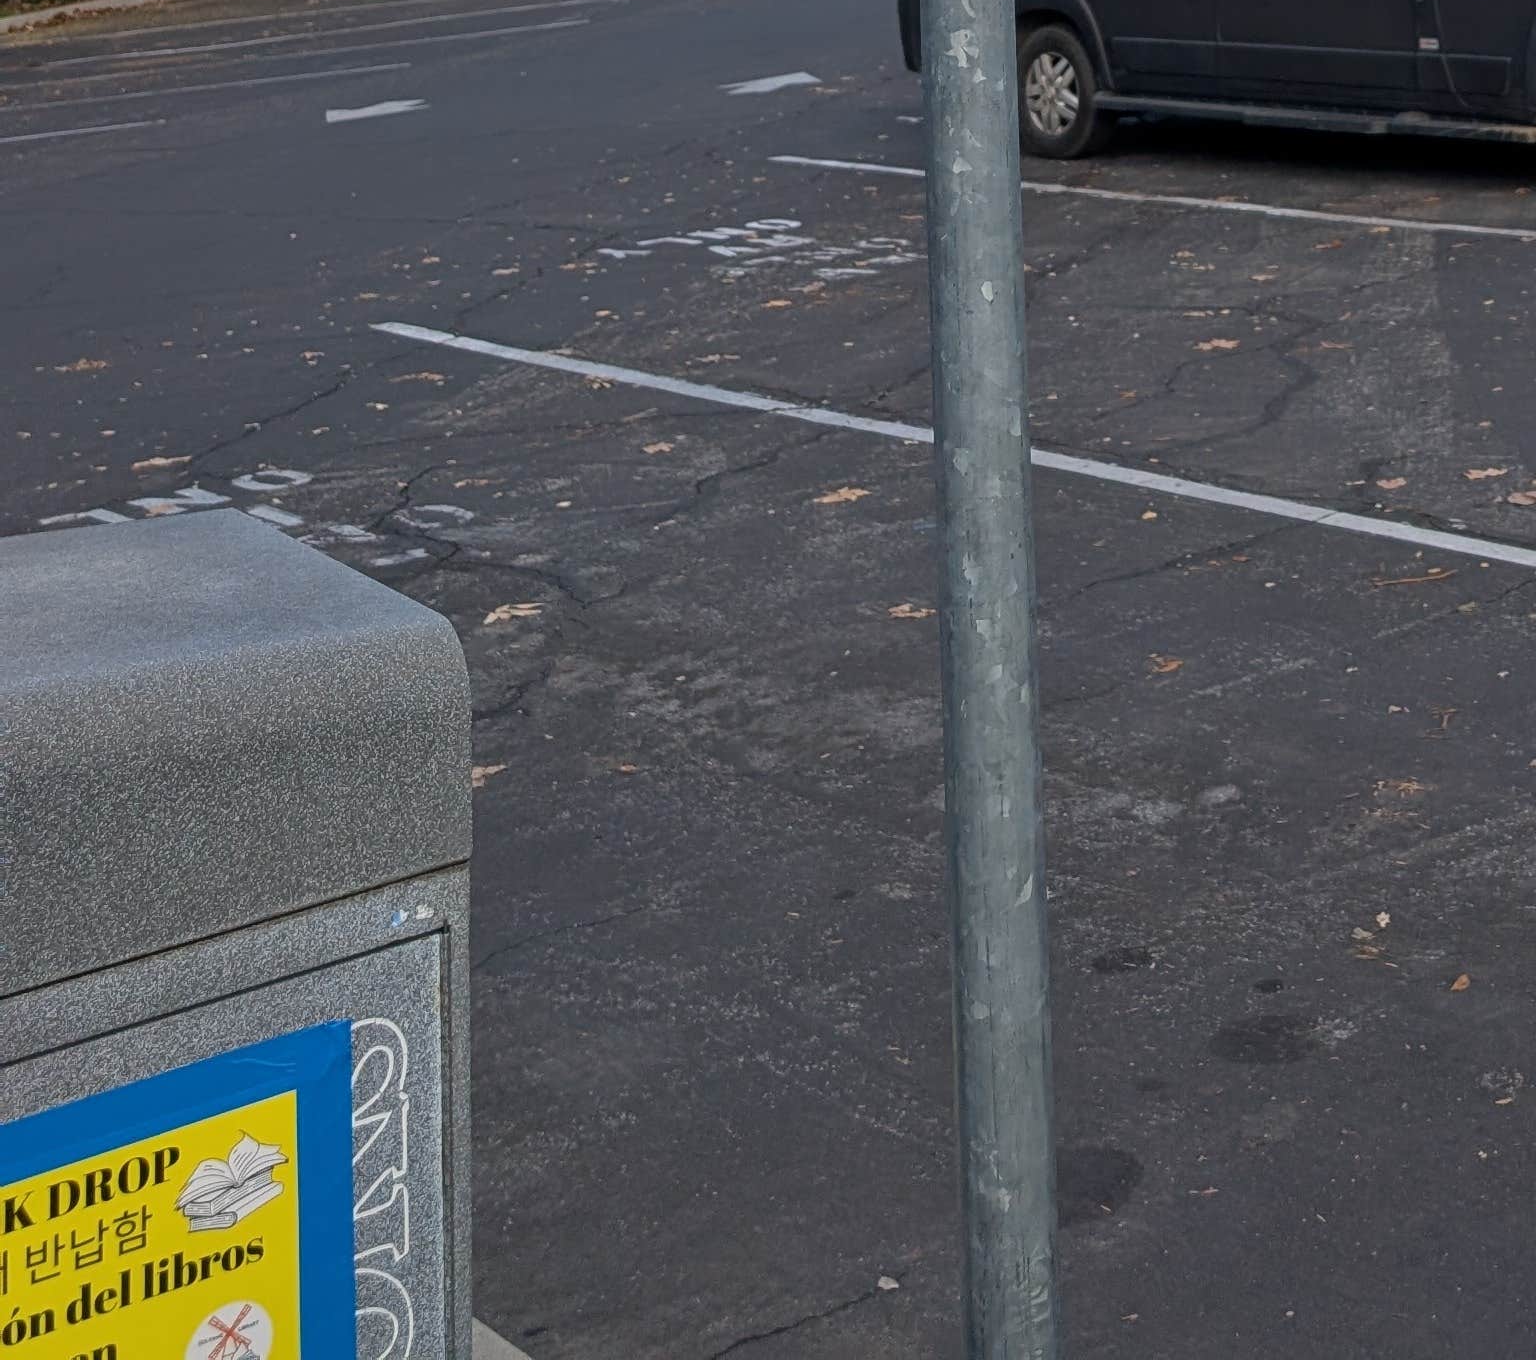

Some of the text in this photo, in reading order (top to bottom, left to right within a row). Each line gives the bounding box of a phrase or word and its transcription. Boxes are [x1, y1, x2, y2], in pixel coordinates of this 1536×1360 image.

[47, 1146, 181, 1221] DROP
[26, 1204, 153, 1286] 반납함
[66, 1268, 131, 1325] del
[142, 1235, 265, 1301] libros
